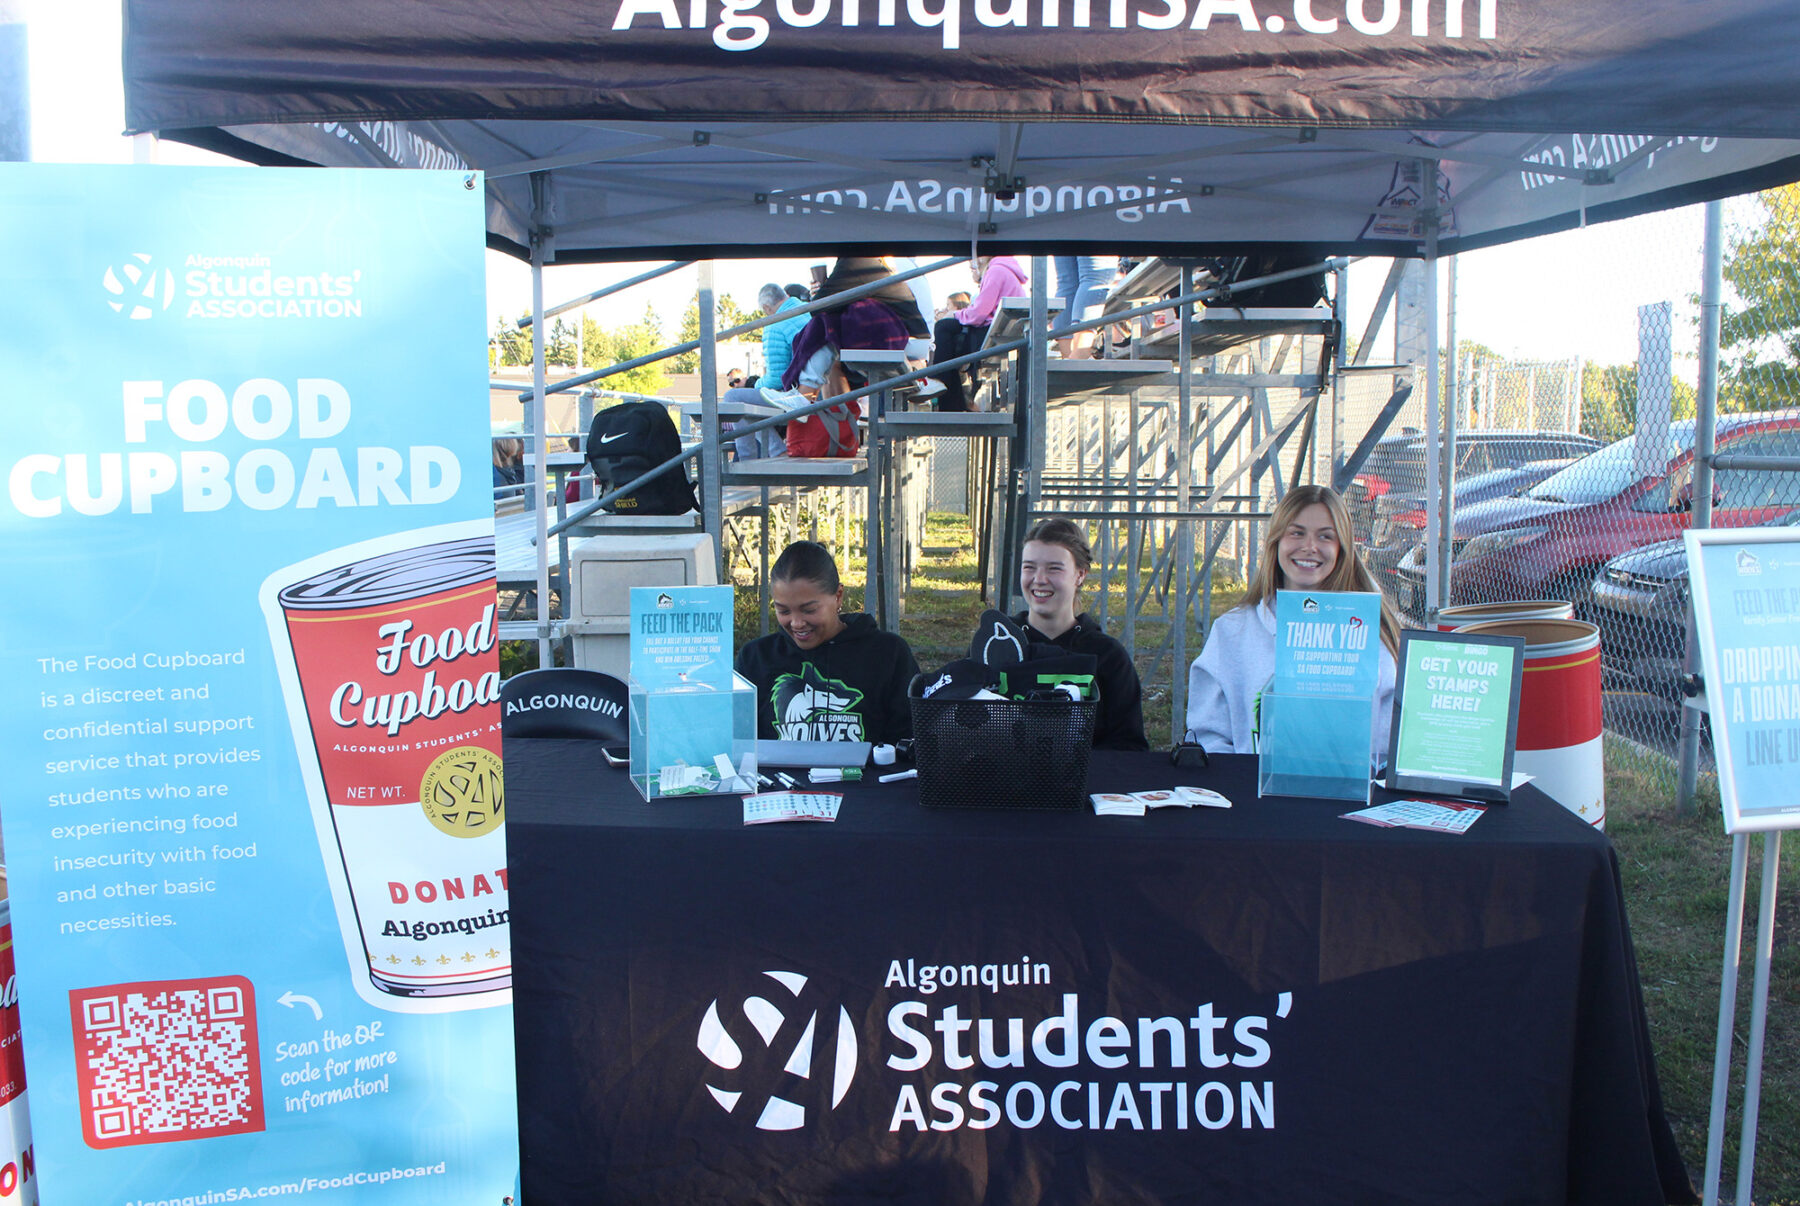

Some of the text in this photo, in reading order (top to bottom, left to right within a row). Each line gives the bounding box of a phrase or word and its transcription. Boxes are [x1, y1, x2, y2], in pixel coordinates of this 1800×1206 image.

[185, 253, 271, 269] Algonquin
[186, 299, 362, 318] ASSOCIATION
[122, 378, 351, 443] FOOD
[8, 445, 462, 518] CUPBOARD
[641, 611, 723, 634] FEED THE PACK
[1286, 621, 1369, 650] THANK YOU
[376, 603, 496, 676] Food
[38, 648, 246, 675] The Food Cupboard
[1420, 656, 1498, 677] GET YOUR
[40, 684, 210, 709] is a discreet and
[1426, 675, 1489, 694] STAMPS
[506, 693, 623, 719] ALGONQUIN
[1431, 693, 1481, 713] HERE!
[1732, 687, 1745, 723] A
[43, 714, 255, 742] confidential support
[45, 746, 261, 775] service that provides
[333, 743, 409, 753] ALGONQUIN
[1745, 728, 1783, 767] LINE
[48, 782, 229, 808] students who are
[347, 785, 406, 799] NET WT.
[51, 811, 238, 841] experiencing food
[53, 842, 257, 873] insecurity with food
[57, 877, 216, 904] and other basic
[59, 911, 177, 935] necessities.
[885, 956, 1050, 993] Algonquin
[275, 1020, 385, 1062] Scan the QR
[281, 1050, 398, 1086] code for more
[285, 1073, 389, 1113] information!
[889, 1080, 1275, 1132] ASSOCIATION
